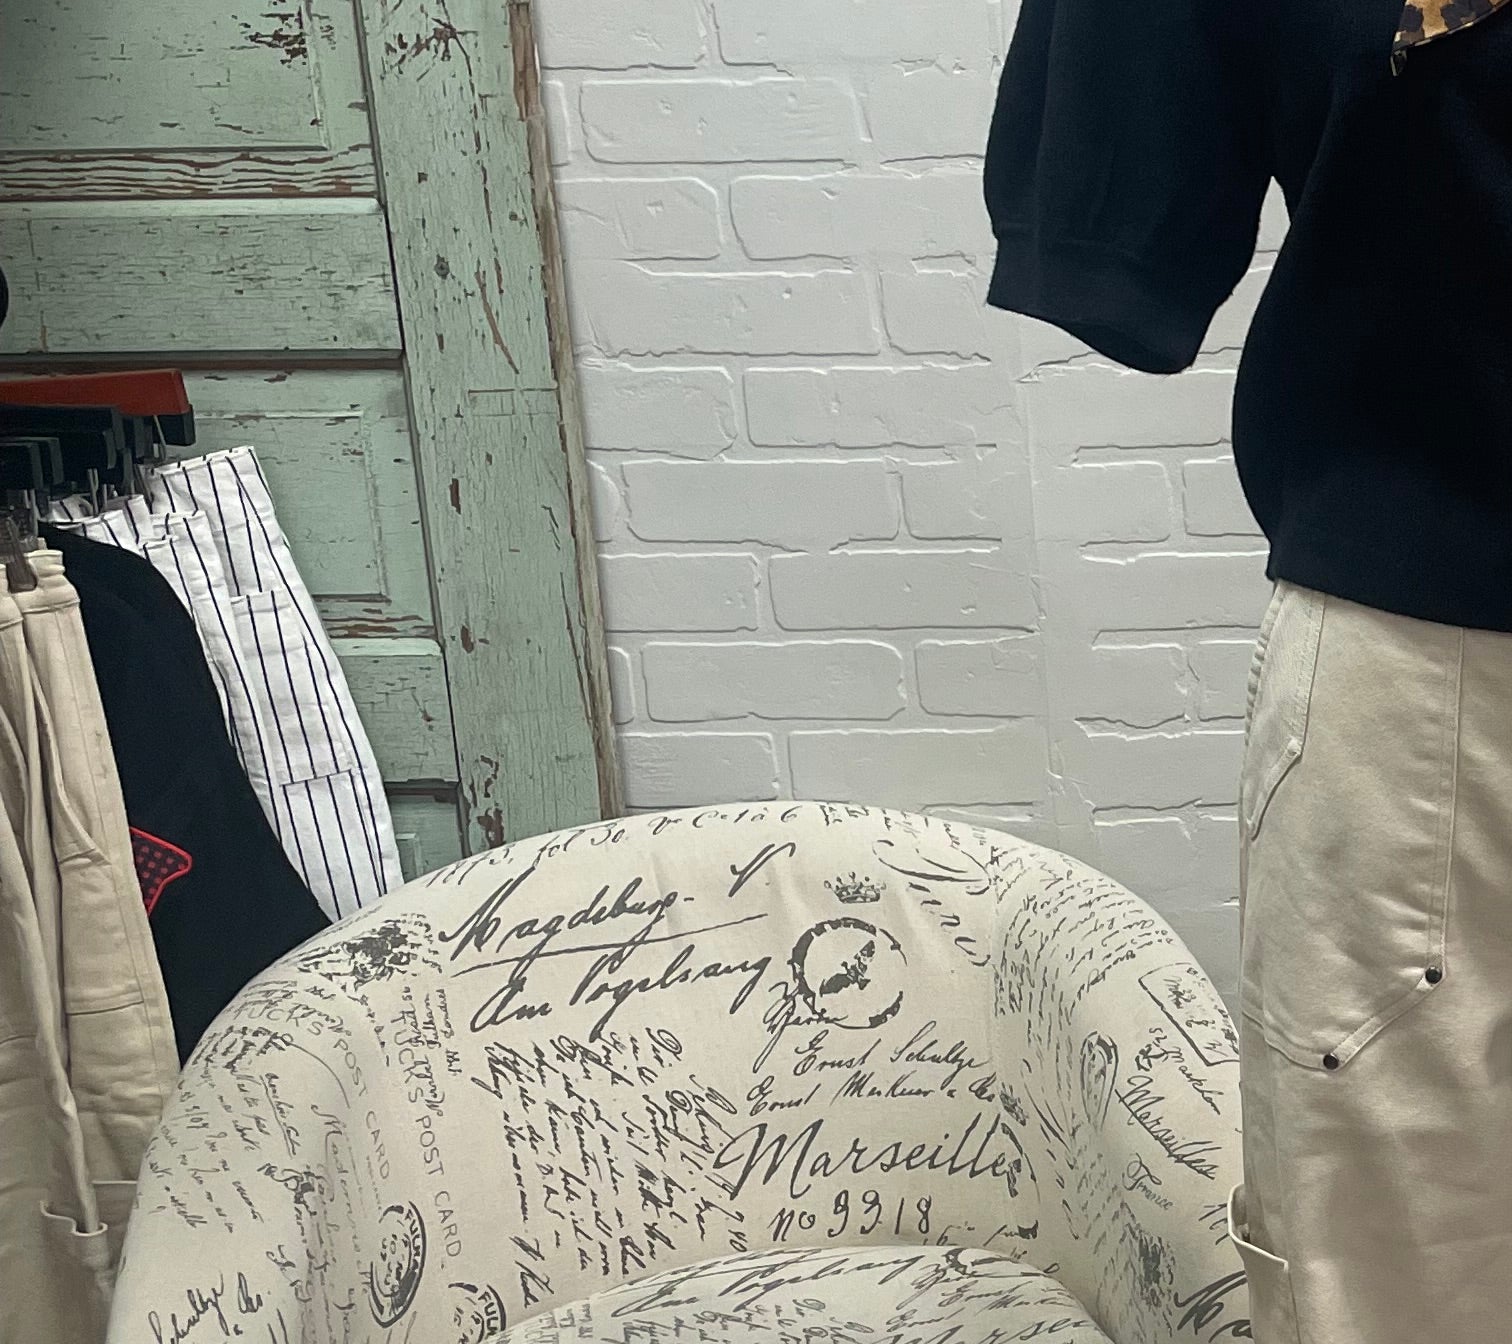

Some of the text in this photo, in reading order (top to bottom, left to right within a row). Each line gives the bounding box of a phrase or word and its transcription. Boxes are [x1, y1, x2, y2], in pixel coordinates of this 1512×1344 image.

[333, 1039, 369, 1097] POST
[365, 1110, 391, 1180] CARD
[415, 1115, 445, 1176] POST
[434, 1191, 462, 1257] CARD
